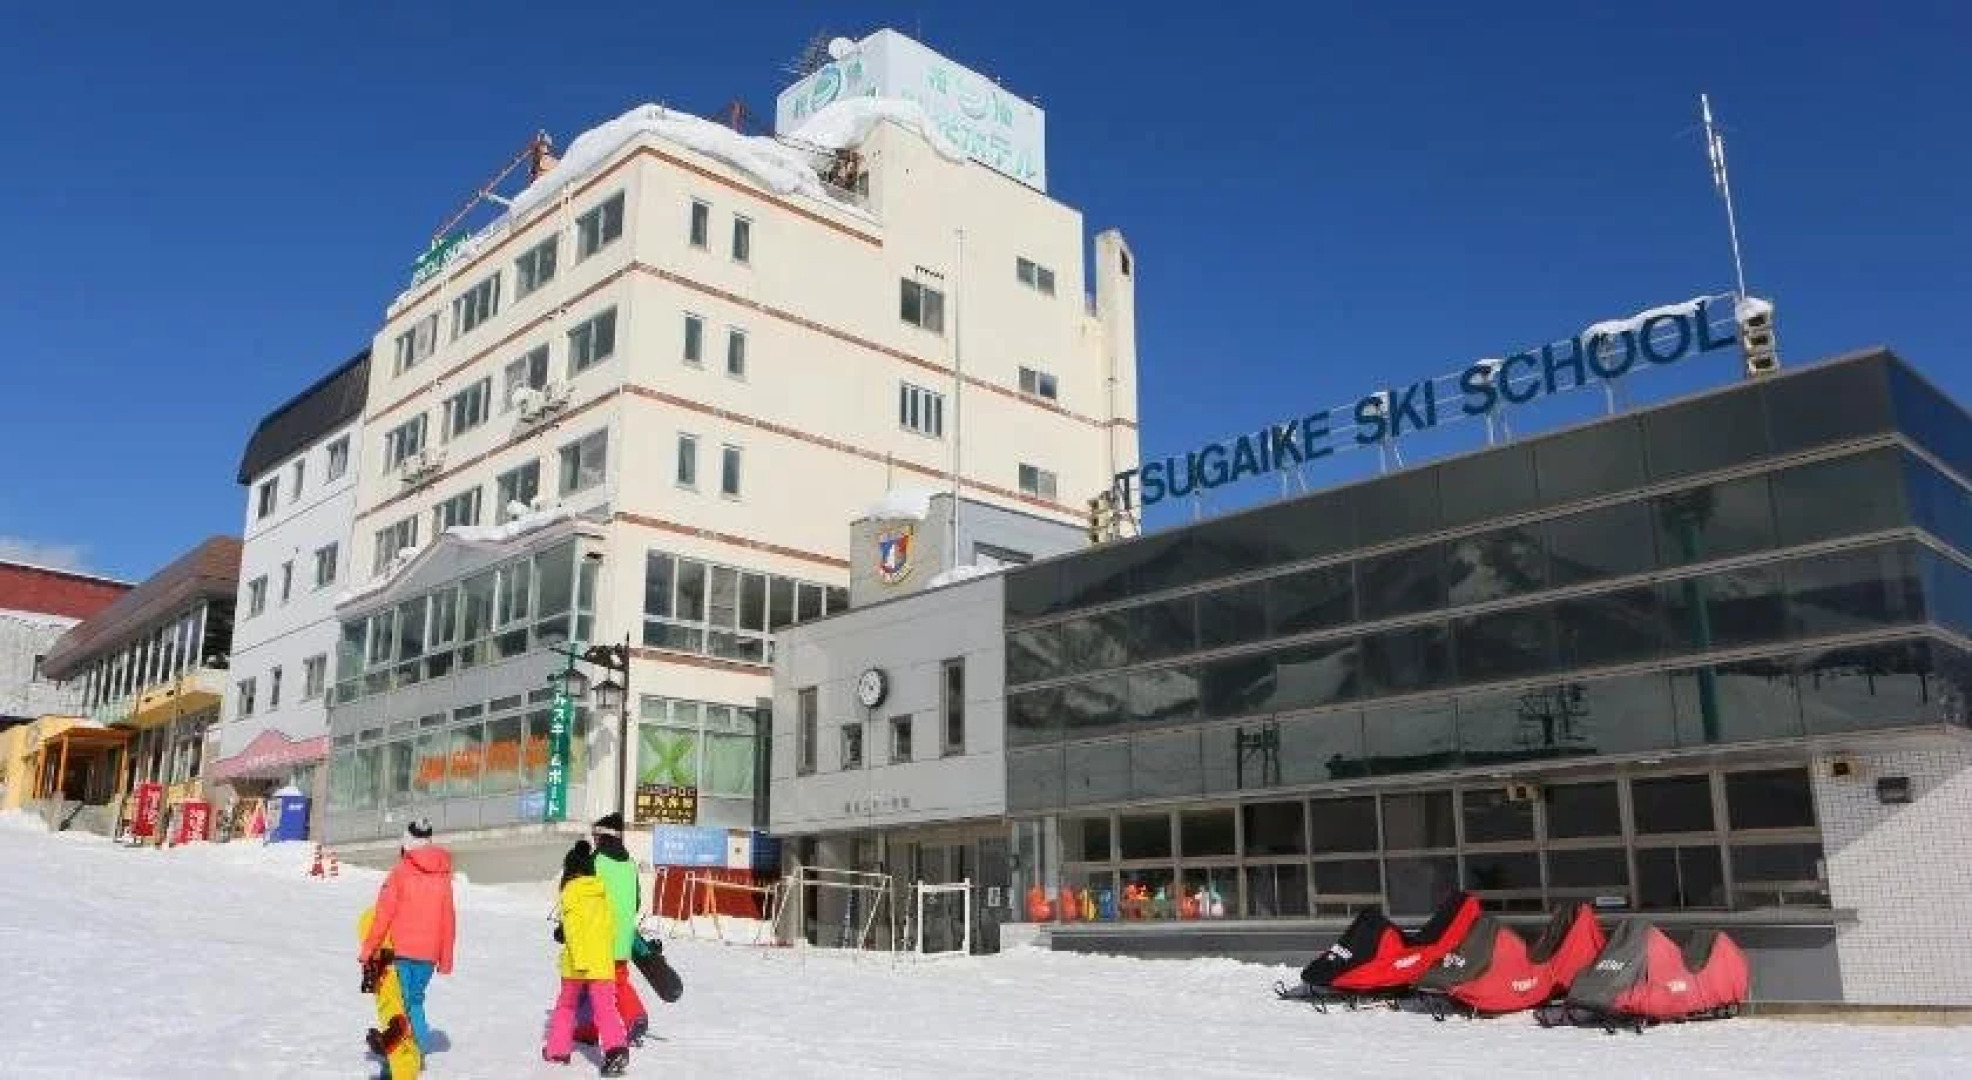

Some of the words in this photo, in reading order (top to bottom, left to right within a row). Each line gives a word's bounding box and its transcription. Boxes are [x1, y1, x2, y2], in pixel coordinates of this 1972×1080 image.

[1115, 411, 1334, 510] TSUGAIKE
[1354, 379, 1437, 445] SKI
[1459, 300, 1737, 416] SCHOOL
